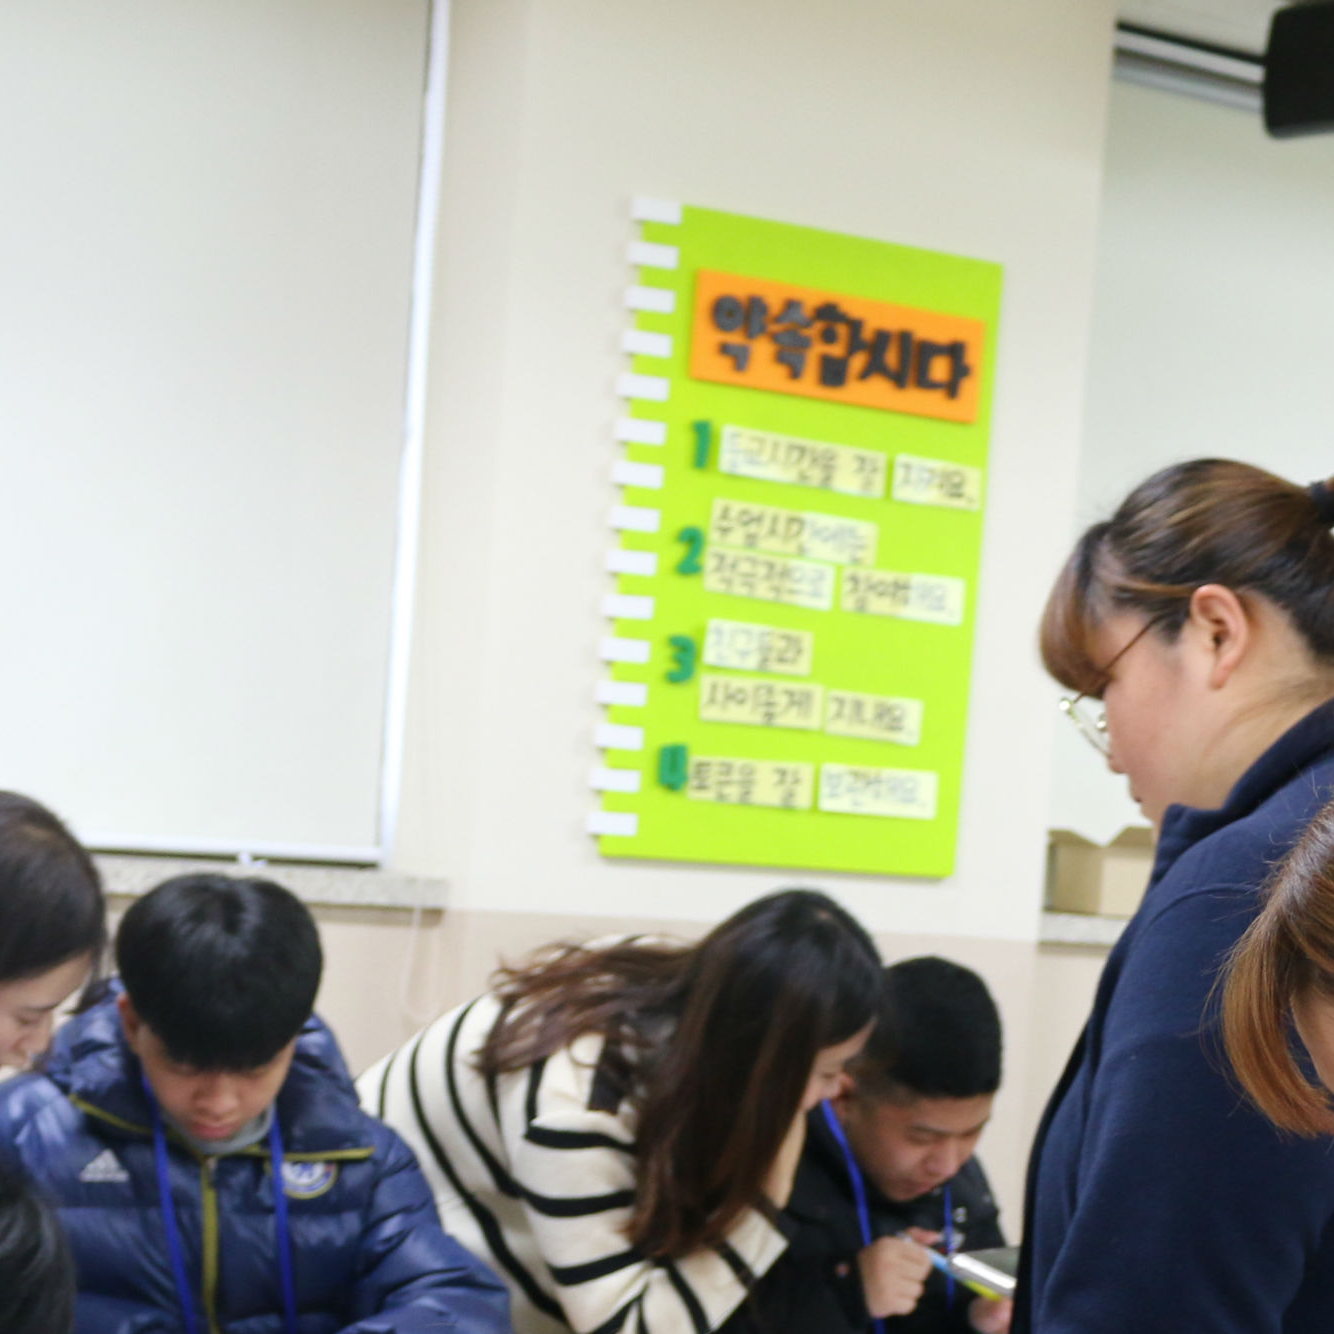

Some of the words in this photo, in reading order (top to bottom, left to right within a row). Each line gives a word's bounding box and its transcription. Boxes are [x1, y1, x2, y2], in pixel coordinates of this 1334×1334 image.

[713, 295, 971, 399] 약속합시다
[691, 420, 713, 469] 1
[675, 527, 705, 576] 2
[665, 636, 696, 683] 3
